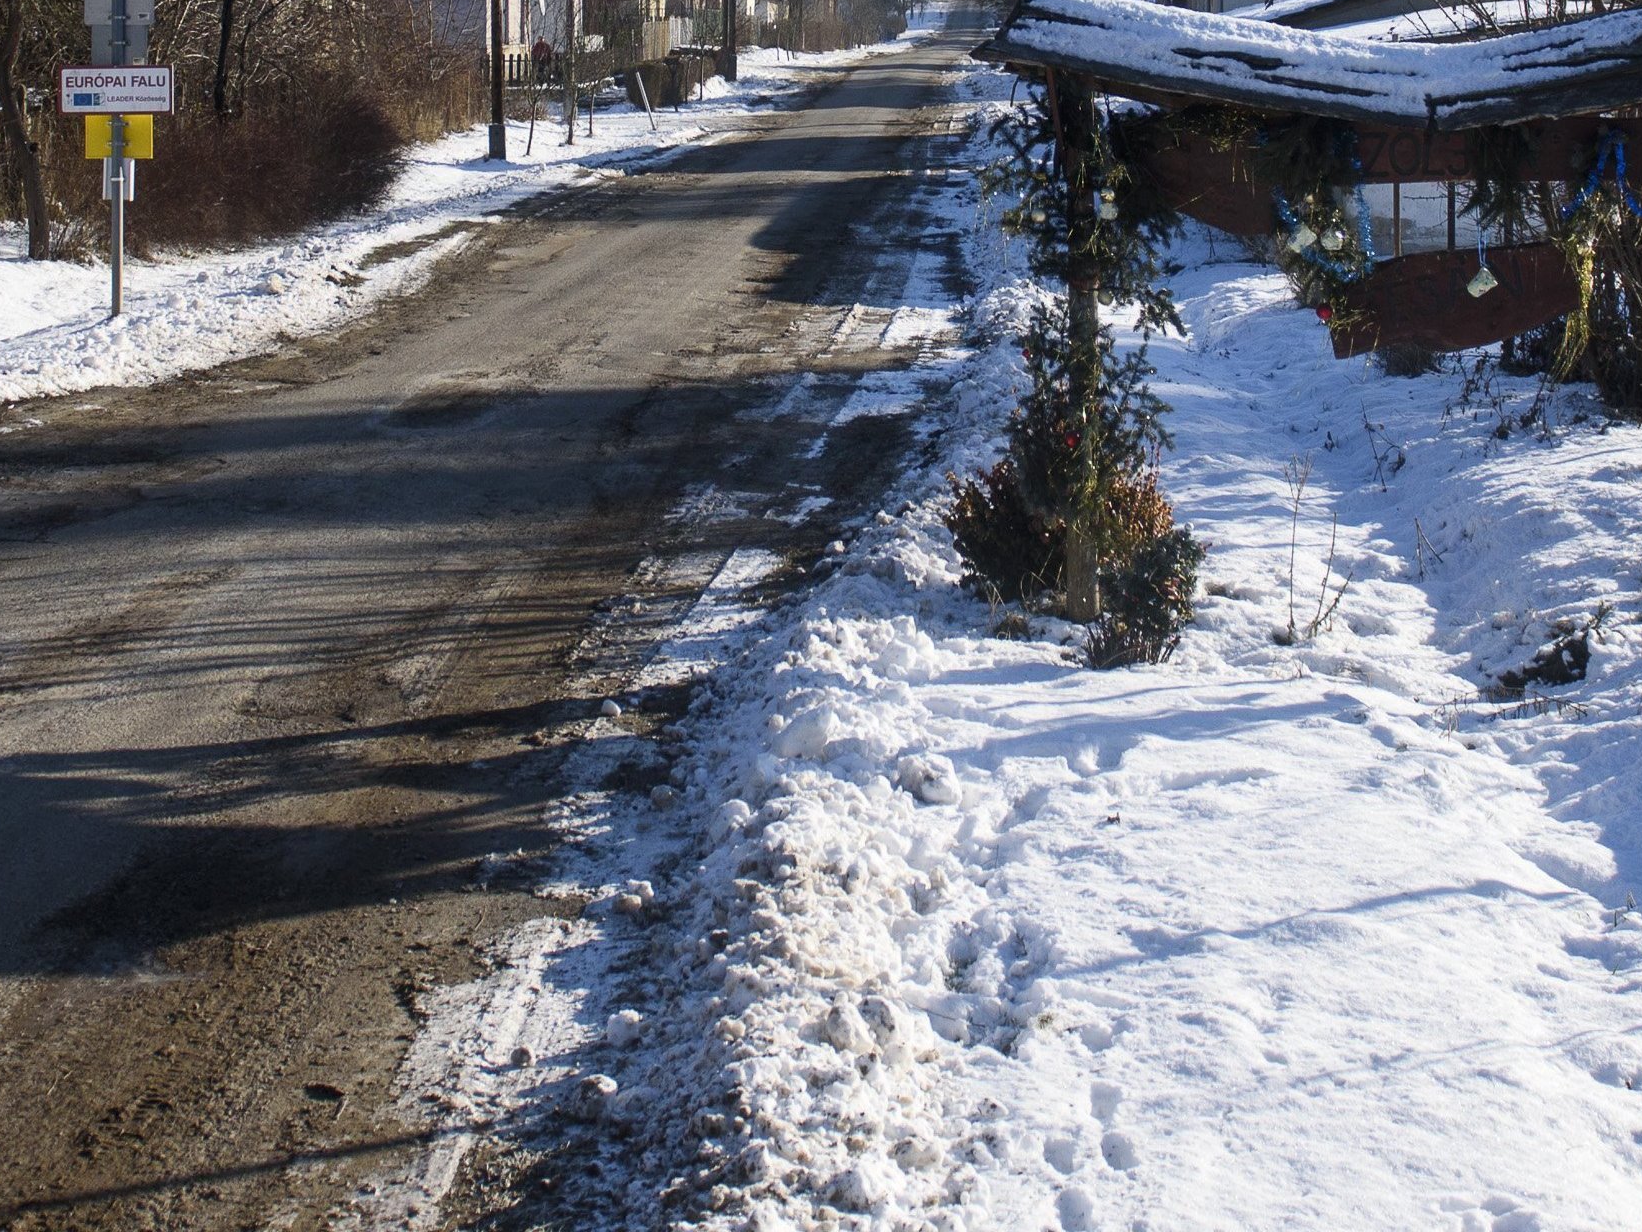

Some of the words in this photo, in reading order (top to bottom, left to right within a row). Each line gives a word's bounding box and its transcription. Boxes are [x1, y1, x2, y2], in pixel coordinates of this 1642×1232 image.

[65, 73, 126, 88] EURÓPAI
[131, 76, 166, 87] FALU
[106, 95, 134, 103] LEADER
[135, 95, 167, 104] Közösség
